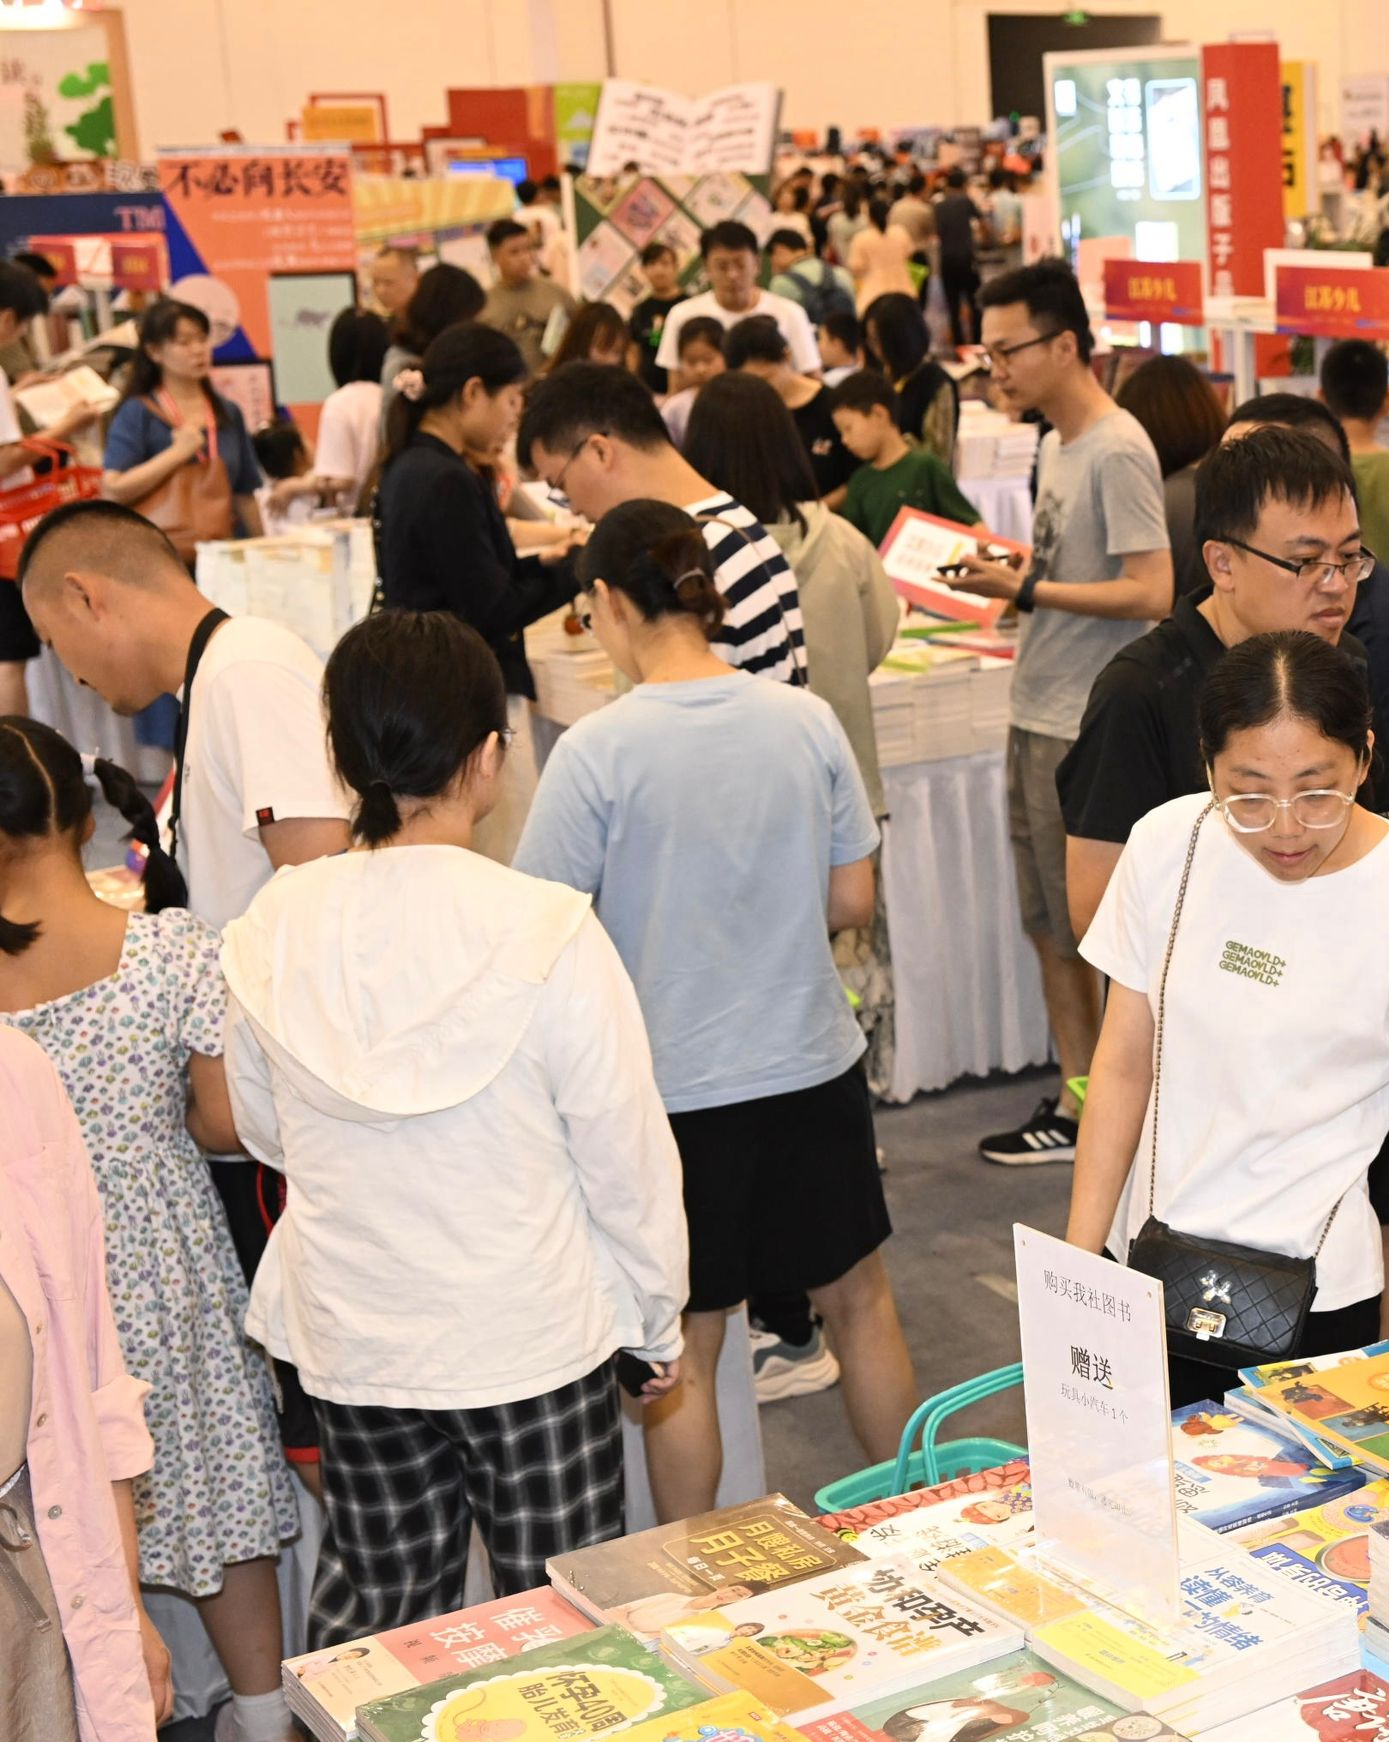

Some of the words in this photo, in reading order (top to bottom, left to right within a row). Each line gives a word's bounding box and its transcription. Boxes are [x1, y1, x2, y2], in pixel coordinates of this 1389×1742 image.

[1043, 1269, 1132, 1323] 购买我社图书
[1070, 1345, 1114, 1390] 赠送
[689, 1530, 791, 1582] 月子餐
[739, 1520, 823, 1570] 月嫂私房
[861, 1568, 986, 1637] 协和孕产
[1180, 1574, 1235, 1608] 读懂
[1204, 1566, 1275, 1604] 从容养育
[809, 1583, 944, 1657] 黄金食谱
[516, 1680, 581, 1734] 胎儿发育
[545, 1671, 629, 1733] 怀孕40周
